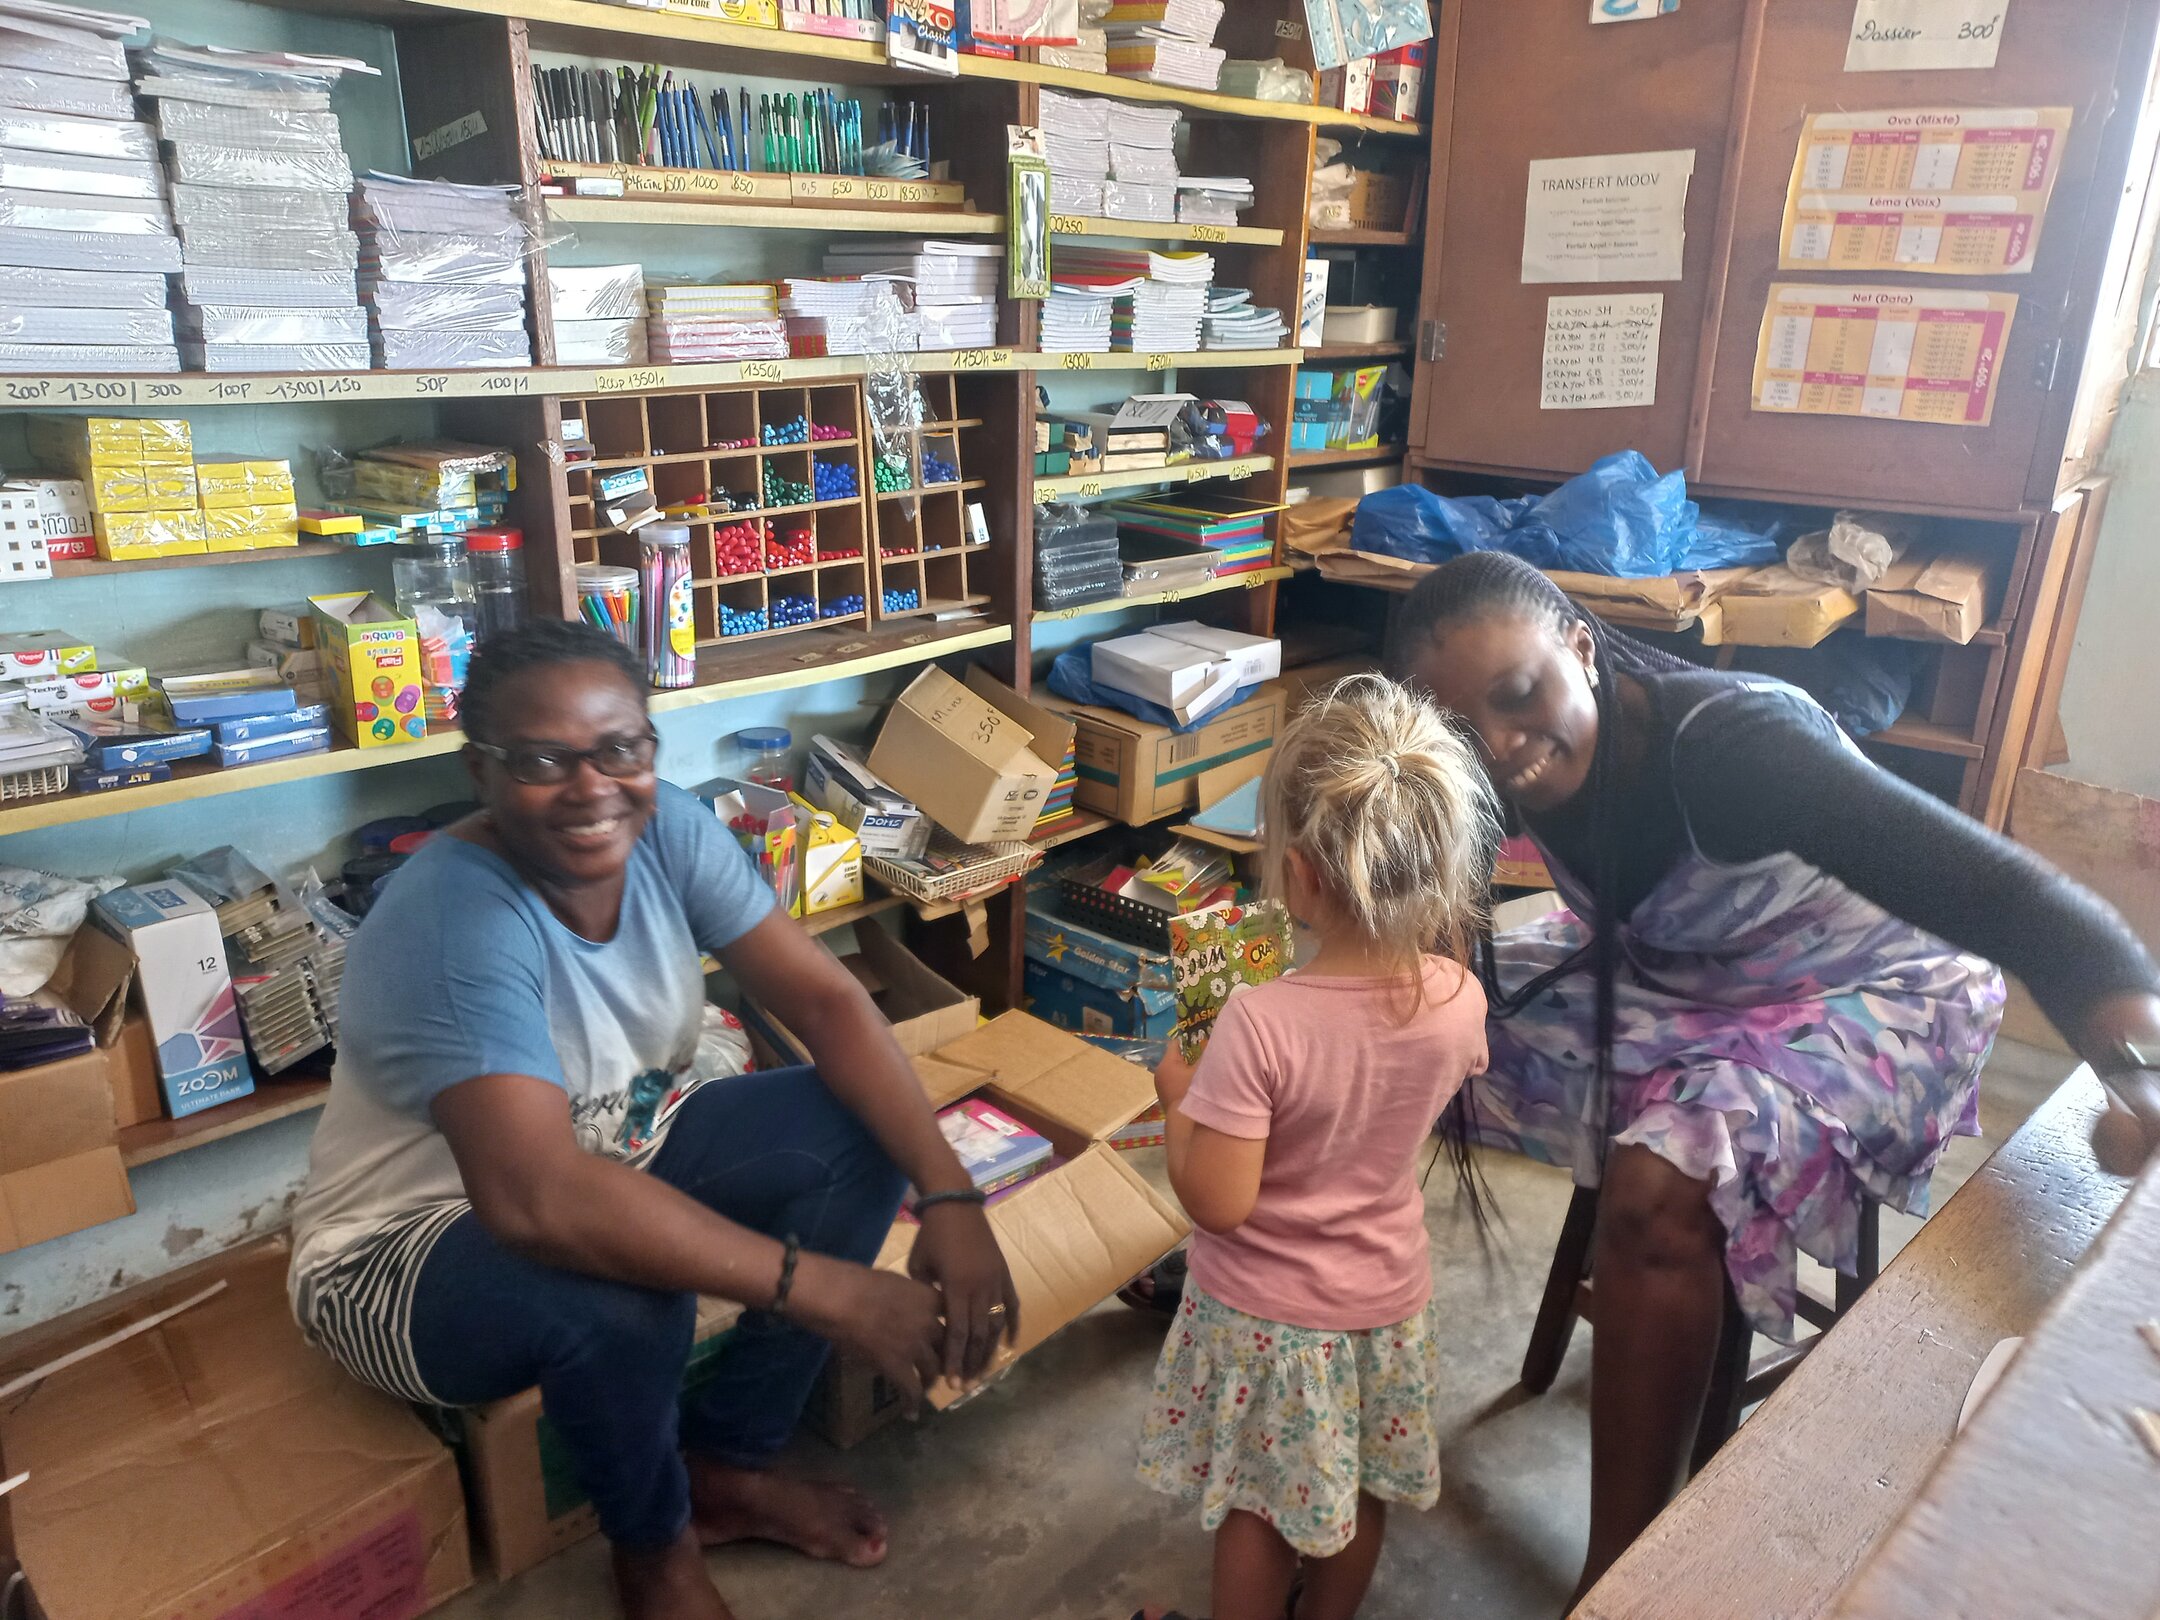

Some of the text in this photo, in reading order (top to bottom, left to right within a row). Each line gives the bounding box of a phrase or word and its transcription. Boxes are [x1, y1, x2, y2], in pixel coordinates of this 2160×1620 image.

[917, 24, 954, 45] Classic
[1856, 22, 1922, 41] Dossier
[690, 174, 719, 190] 1000
[1541, 172, 1660, 192] TRANSFERT MOOV
[1852, 294, 1913, 305] Net (Data)
[1550, 308, 1592, 317] CRAYON
[1547, 333, 1581, 341] CRAYON
[1547, 344, 1584, 353] CRAYON
[1546, 358, 1581, 367] CRAYON
[1546, 370, 1581, 379] CRAYON
[5, 380, 51, 400] 200P
[208, 382, 252, 399] 100P
[416, 375, 449, 393] 50P
[1546, 382, 1586, 392] CRAYON
[1545, 393, 1587, 403] CRAYON
[361, 630, 405, 642] Bubble
[864, 816, 902, 828] DOMS
[197, 956, 218, 972] 12
[1073, 946, 1131, 975] Golden Star
[178, 1065, 239, 1097] ZOOM
